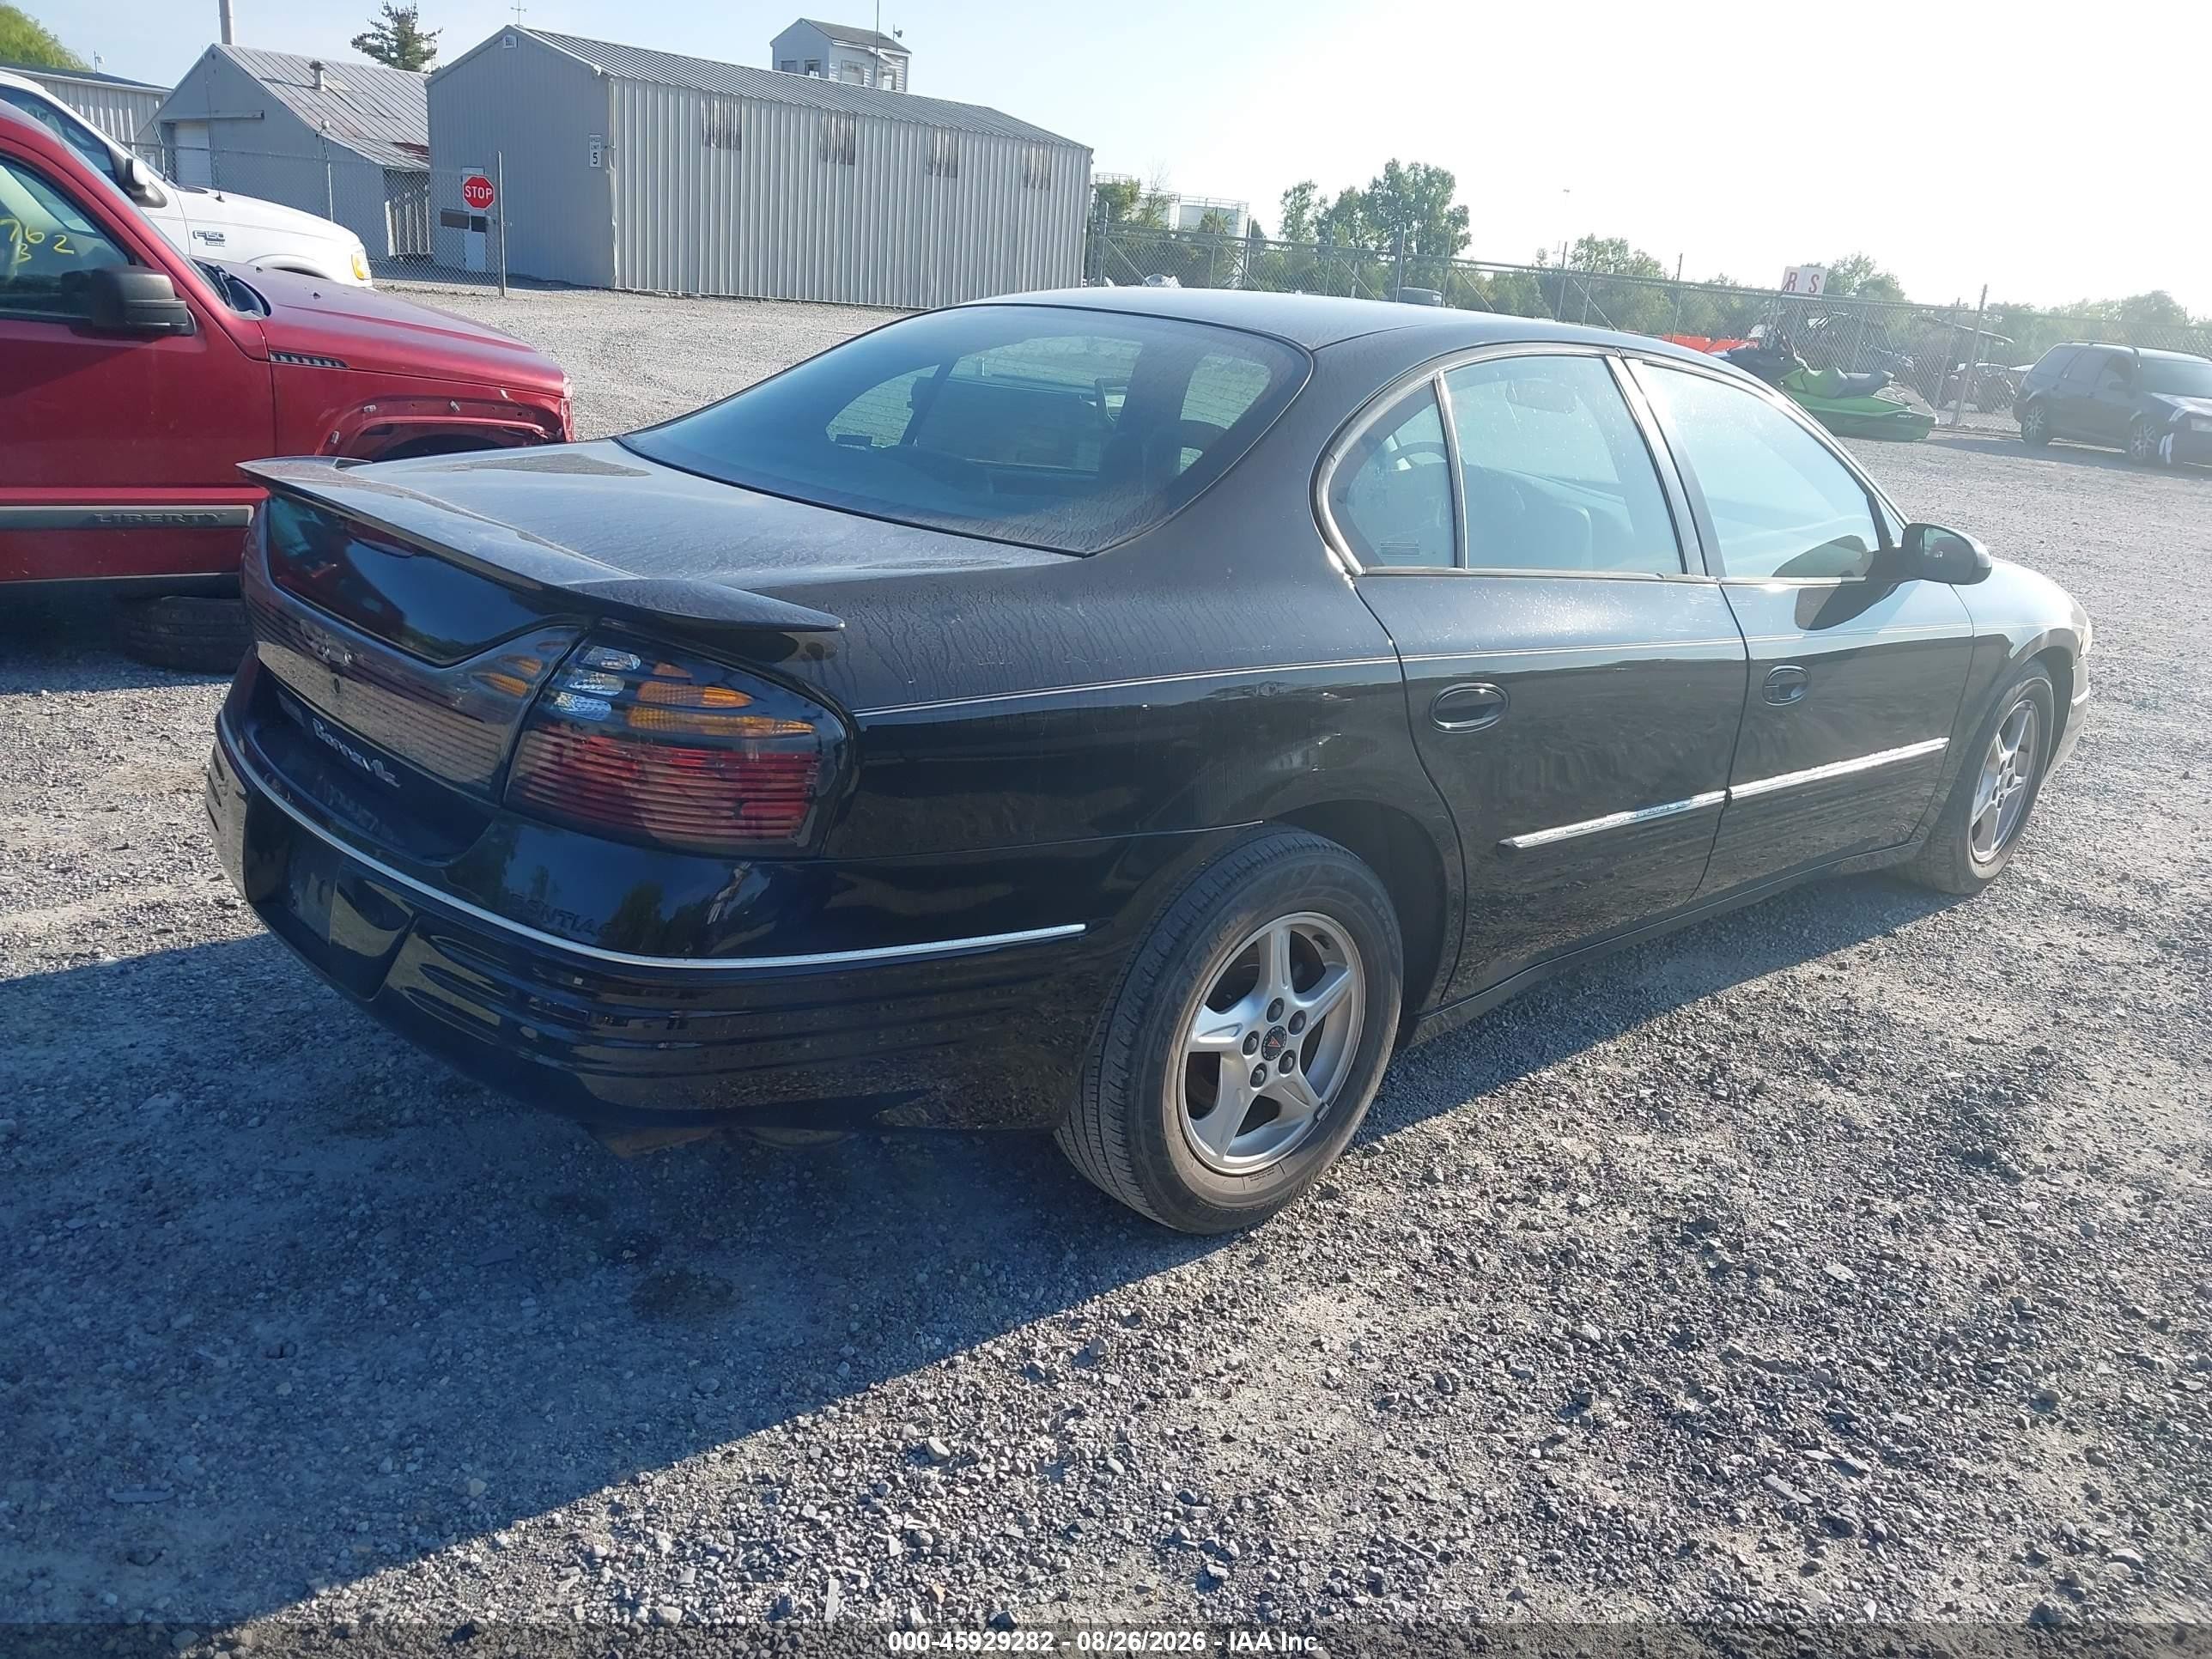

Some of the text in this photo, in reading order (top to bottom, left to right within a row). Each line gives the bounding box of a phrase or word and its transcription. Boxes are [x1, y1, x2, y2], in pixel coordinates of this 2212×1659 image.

[592, 152, 598, 164] 5
[465, 185, 493, 199] STOP
[1786, 271, 1820, 294] R S
[94, 514, 227, 523] LIBERTY
